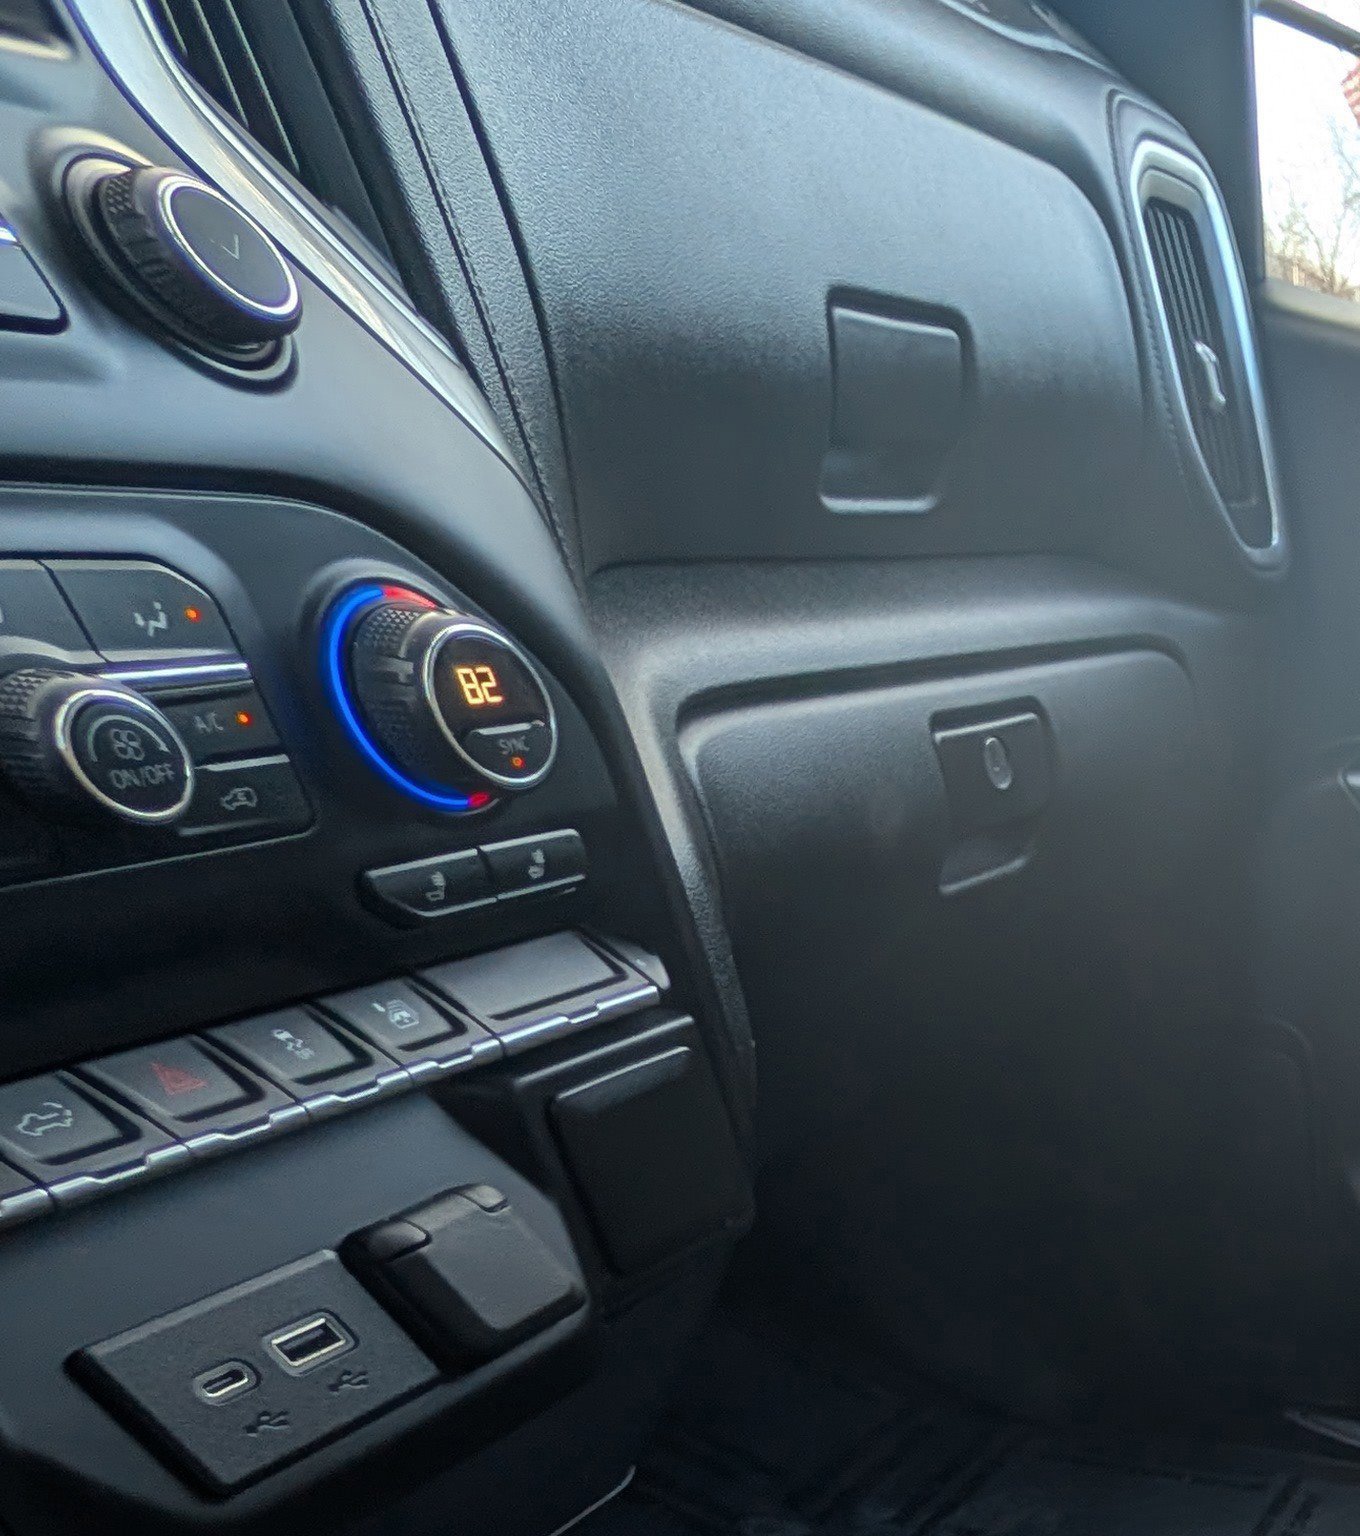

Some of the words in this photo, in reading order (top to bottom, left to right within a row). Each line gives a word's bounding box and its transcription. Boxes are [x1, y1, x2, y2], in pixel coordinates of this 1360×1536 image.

[455, 664, 504, 706] 82
[193, 710, 224, 734] A/C
[499, 735, 531, 755] SYNC
[109, 762, 176, 790] ON/OFF
